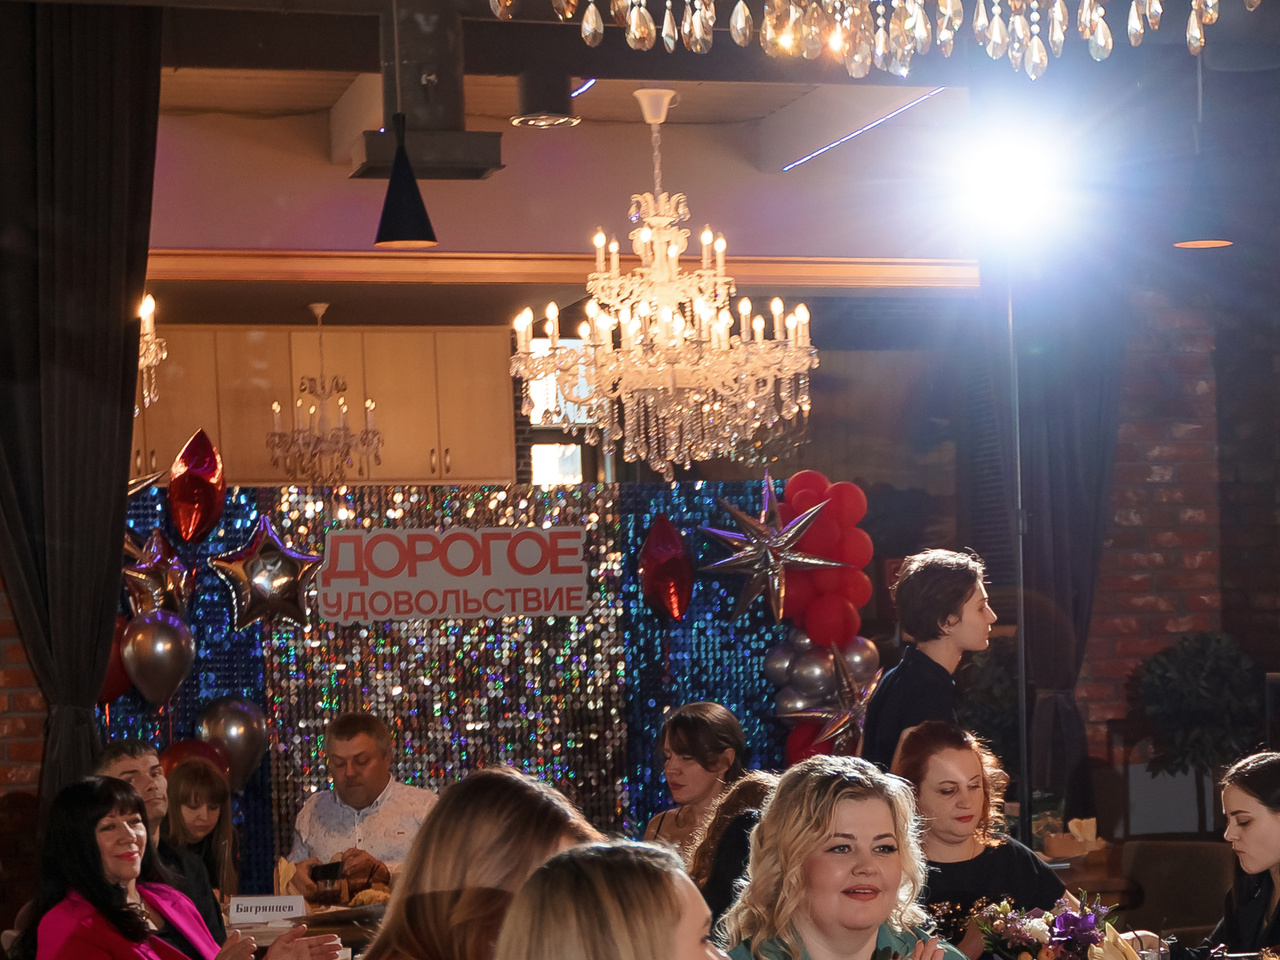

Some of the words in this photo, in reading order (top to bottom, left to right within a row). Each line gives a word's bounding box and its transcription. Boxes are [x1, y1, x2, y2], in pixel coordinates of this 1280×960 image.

[321, 531, 584, 587] ДОРОГОЕ
[322, 586, 585, 620] УДОВОЛЬСТВИЕ
[235, 903, 294, 915] Багрянцев
